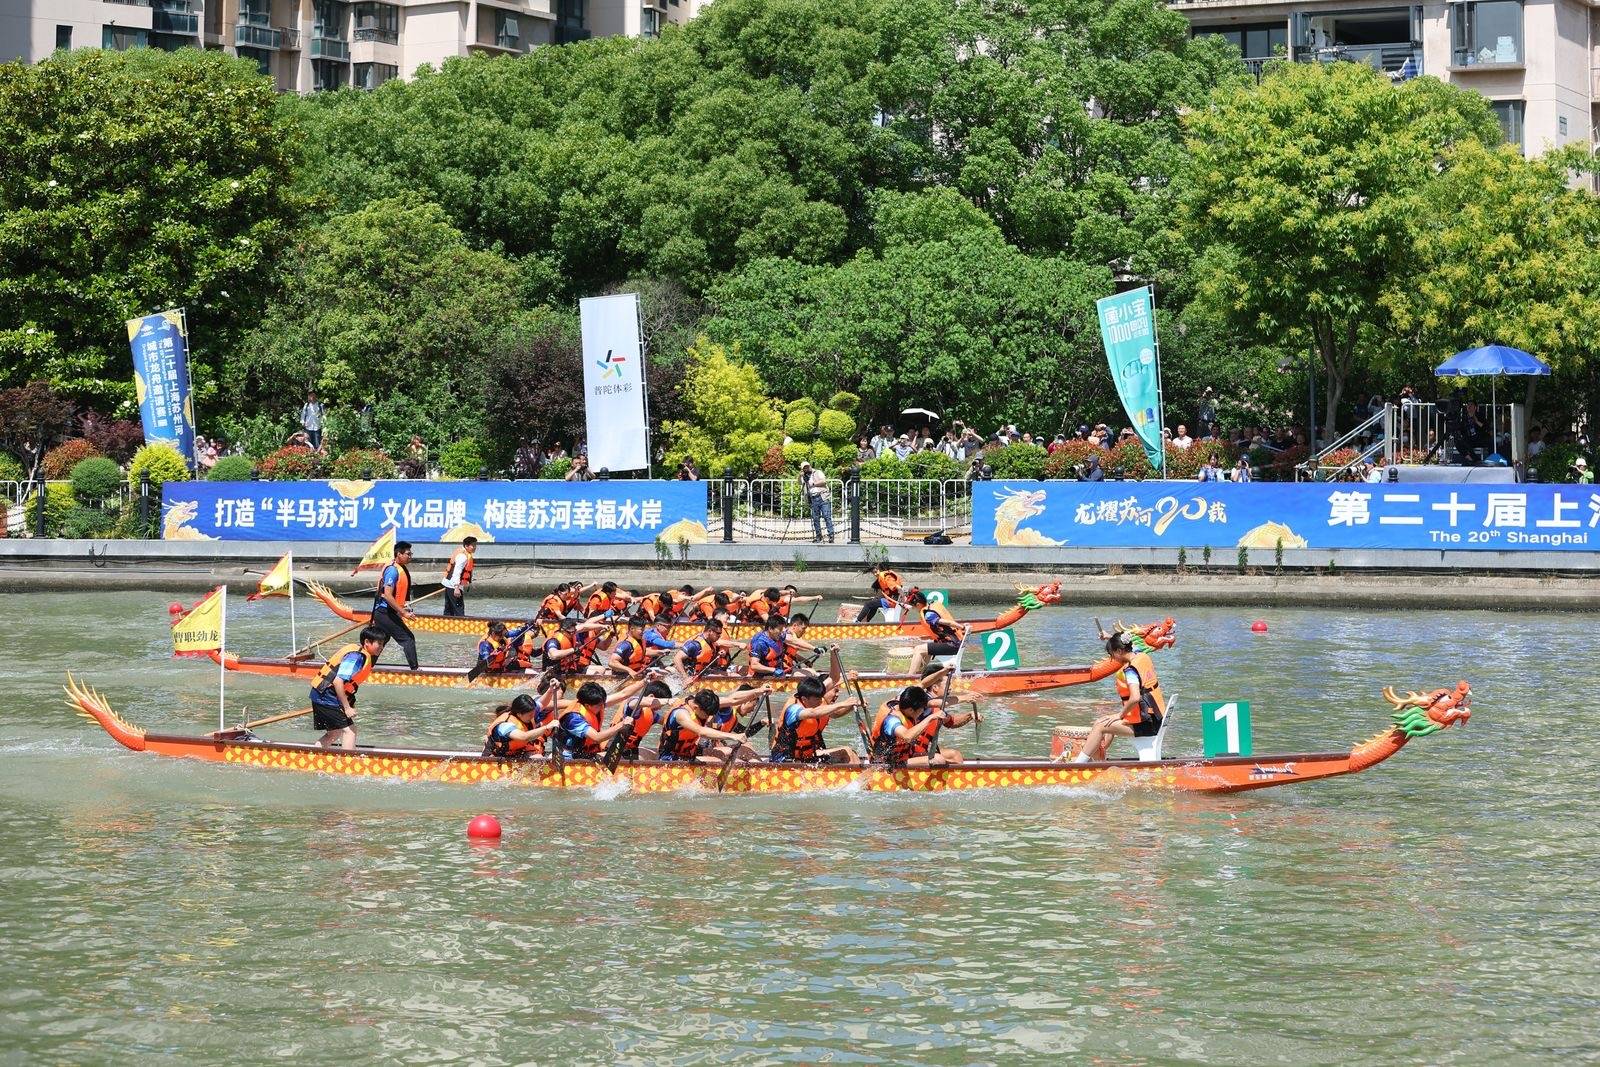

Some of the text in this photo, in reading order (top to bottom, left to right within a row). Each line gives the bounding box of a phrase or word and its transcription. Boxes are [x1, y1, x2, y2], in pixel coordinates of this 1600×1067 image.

[163, 337, 184, 436] 第二十届上海苏州河
[594, 383, 632, 395] 普陀体彩
[215, 497, 662, 531] 打造“半马苏河”文化品牌 构建苏河幸福水岸
[1327, 491, 1600, 528] 第二十届上
[1429, 529, 1588, 546] The 20th Shanghai
[987, 631, 1016, 669] 2
[1214, 702, 1240, 754] 1
